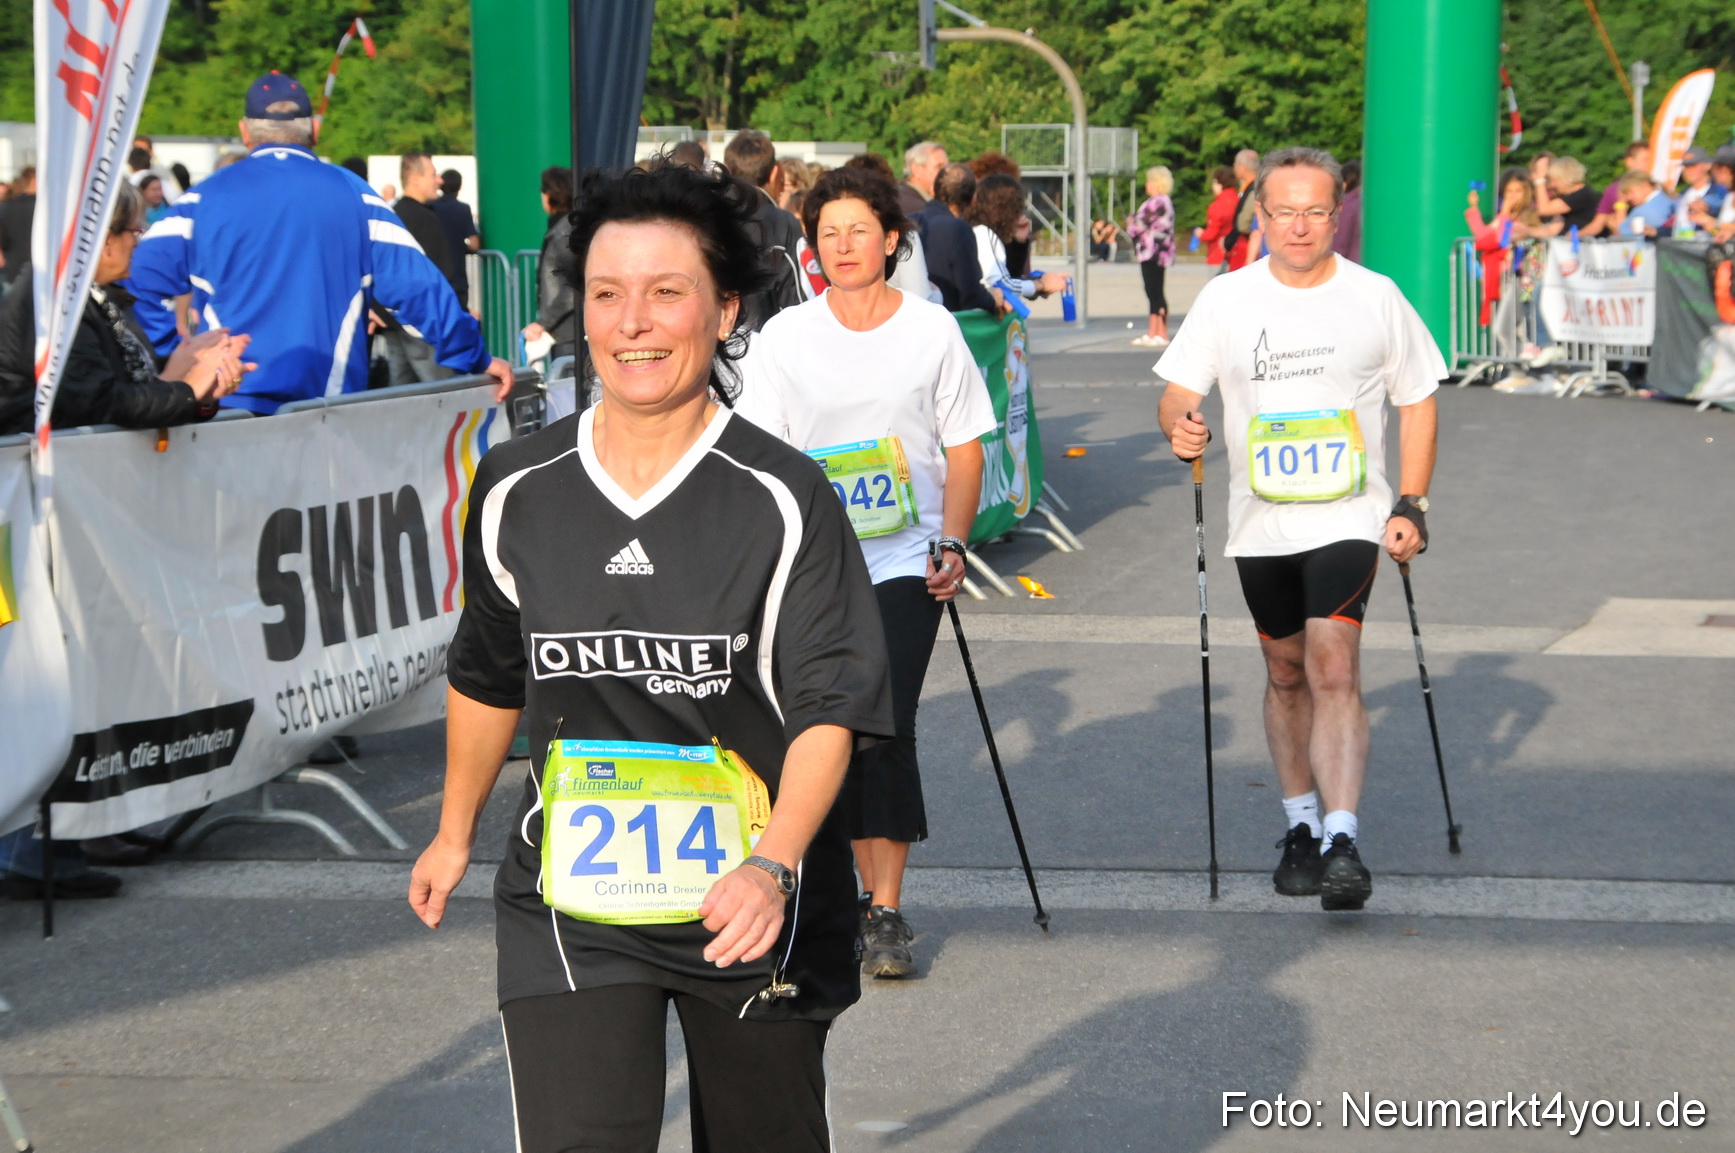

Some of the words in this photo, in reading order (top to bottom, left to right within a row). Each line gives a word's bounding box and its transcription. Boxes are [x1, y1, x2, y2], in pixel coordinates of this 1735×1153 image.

[1270, 347, 1335, 361] EVANGELISCH
[1269, 363, 1280, 371] IN
[1269, 367, 1324, 381] NEUMARKT
[1256, 442, 1346, 477] 1017
[257, 484, 438, 661] swn
[605, 561, 654, 575] adidas
[539, 636, 713, 673] ONLINE
[276, 654, 398, 735] stadtwerke
[646, 676, 731, 699] Germany
[130, 741, 160, 769] die
[164, 728, 235, 764] verbinden
[573, 777, 644, 791] firmenlauf
[569, 804, 727, 877] 214
[595, 880, 667, 895] Corinna
[673, 885, 706, 894] Drexler
[625, 901, 678, 909] Schreibgeräte
